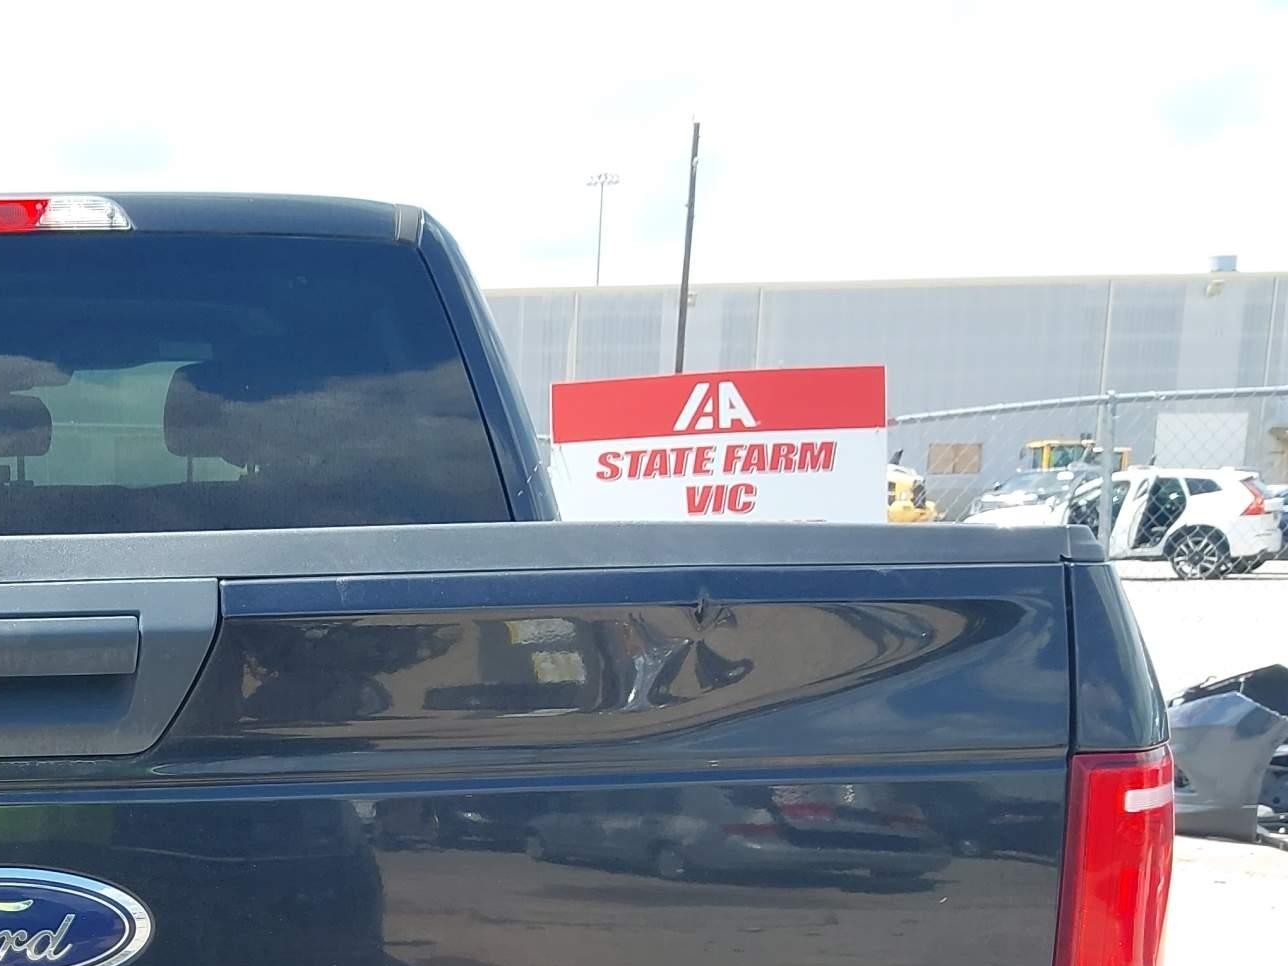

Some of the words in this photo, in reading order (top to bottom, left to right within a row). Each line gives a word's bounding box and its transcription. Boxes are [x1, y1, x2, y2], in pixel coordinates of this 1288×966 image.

[596, 446, 715, 480] STATE
[723, 441, 837, 474] FARM
[686, 483, 757, 515] VIC
